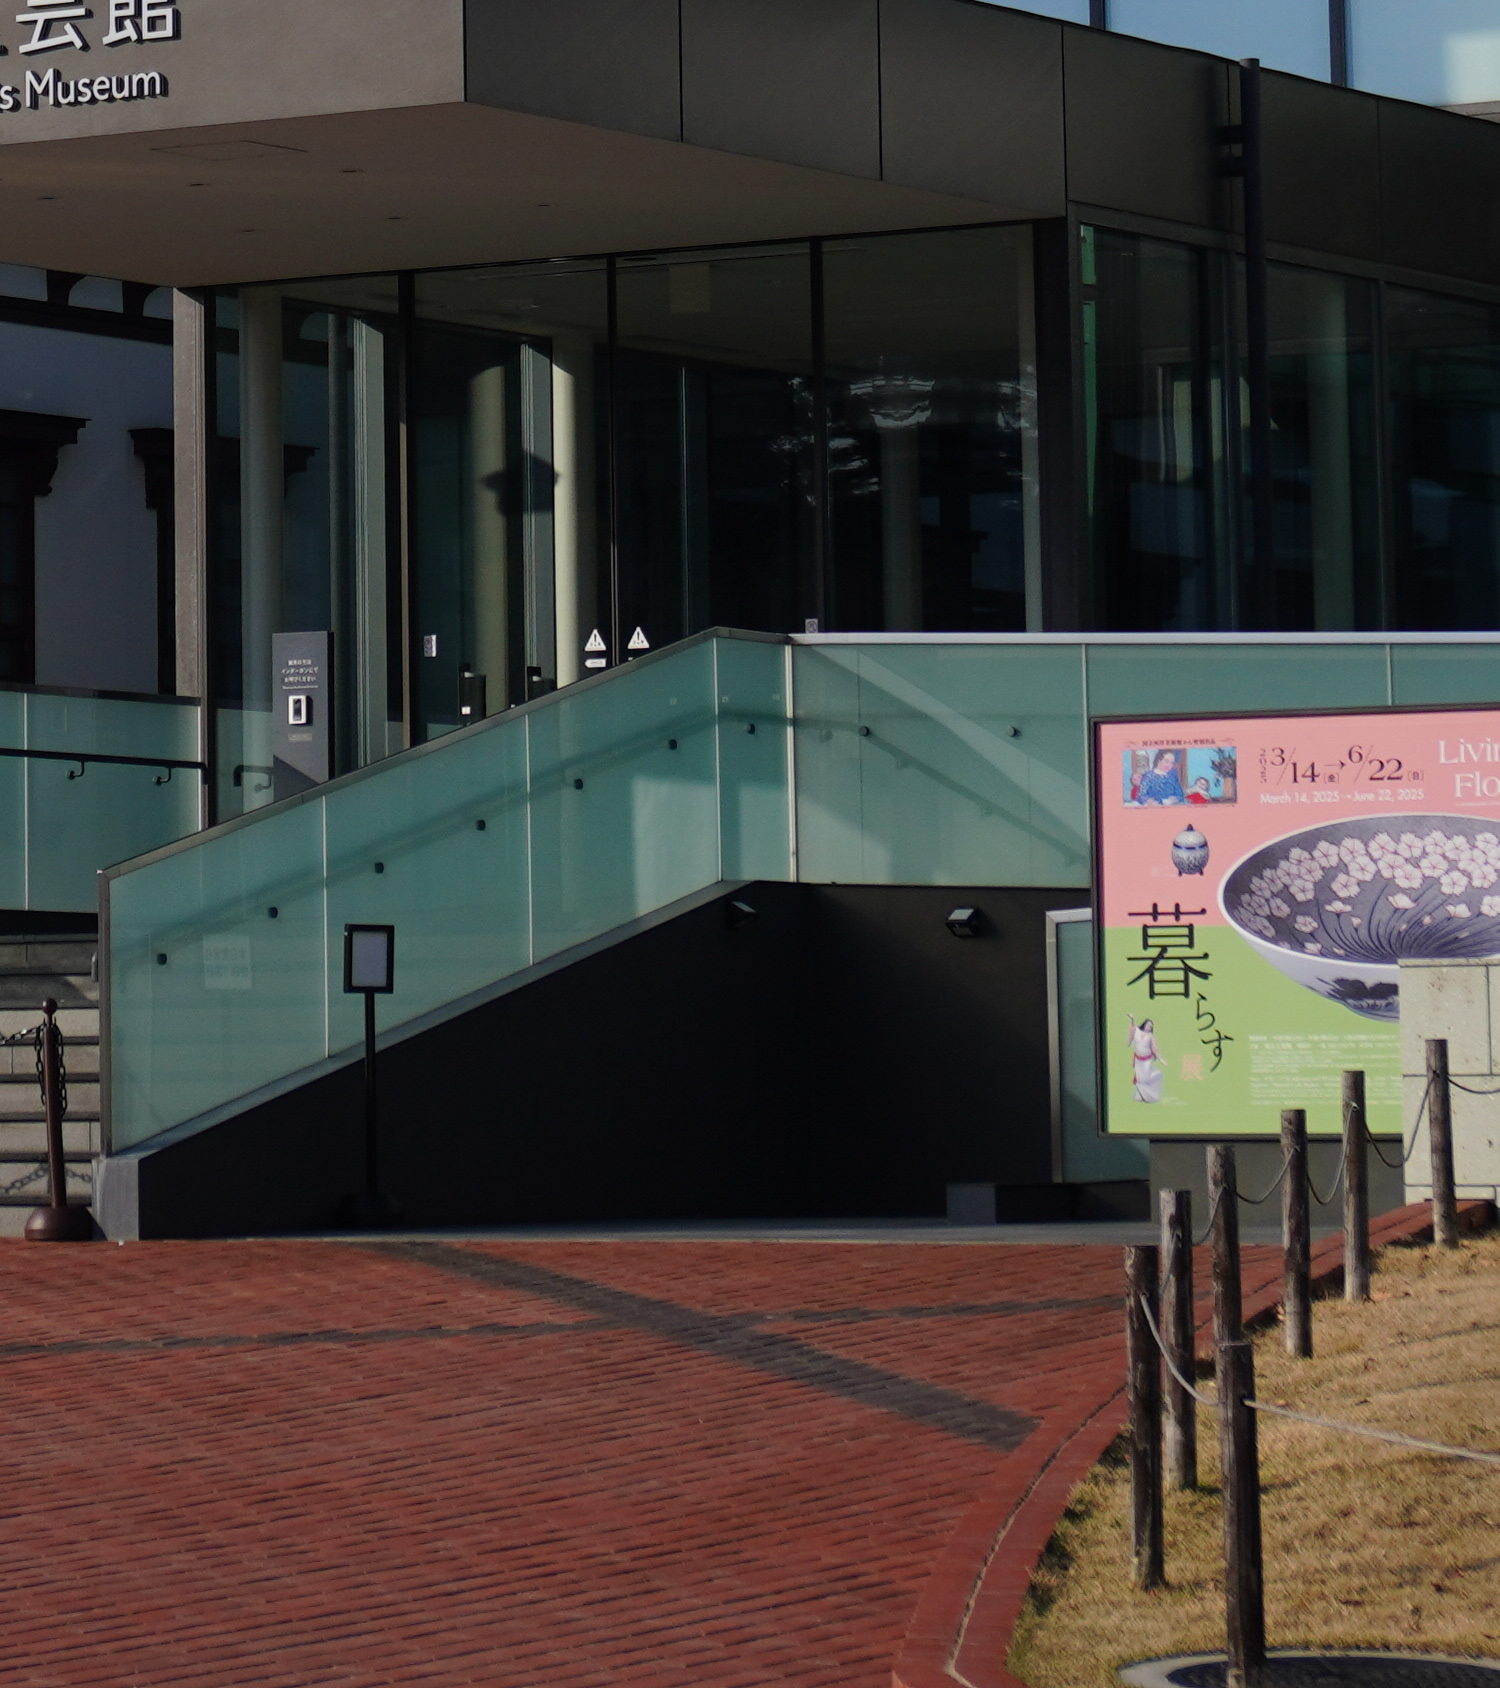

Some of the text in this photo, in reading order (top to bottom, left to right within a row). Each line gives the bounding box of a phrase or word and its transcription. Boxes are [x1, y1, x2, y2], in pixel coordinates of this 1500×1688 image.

[23, 67, 167, 110] Museum
[1260, 791, 1291, 804] March
[1313, 791, 1340, 803] 2025
[1352, 789, 1375, 802] June
[1397, 788, 1425, 801] 2025
